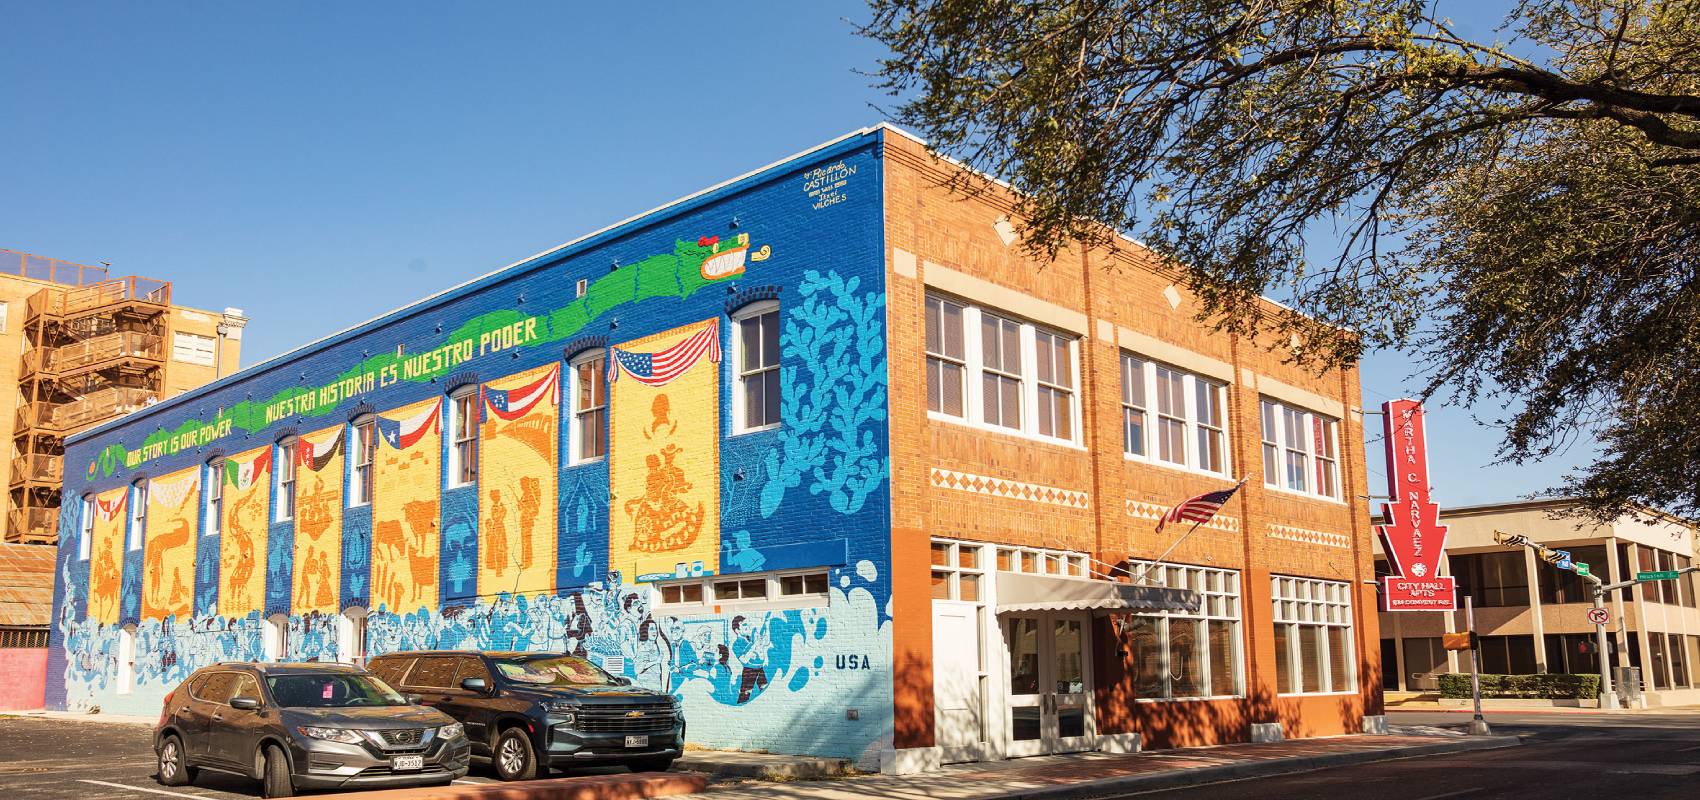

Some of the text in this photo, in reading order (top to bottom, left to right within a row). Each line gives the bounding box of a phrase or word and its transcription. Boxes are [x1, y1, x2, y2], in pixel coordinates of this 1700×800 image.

[803, 164, 857, 192] CASTILLON
[812, 194, 847, 210] VILCHES
[265, 316, 538, 424] NUESTRA HISTORIA ES NUESTRO PODER
[126, 418, 233, 468] OUR STORY IS OUR POWER
[1401, 409, 1417, 465] MARTHA
[1409, 491, 1423, 558] NARVAEZ
[1396, 582, 1446, 591] CITY HALL
[835, 654, 871, 670] USA
